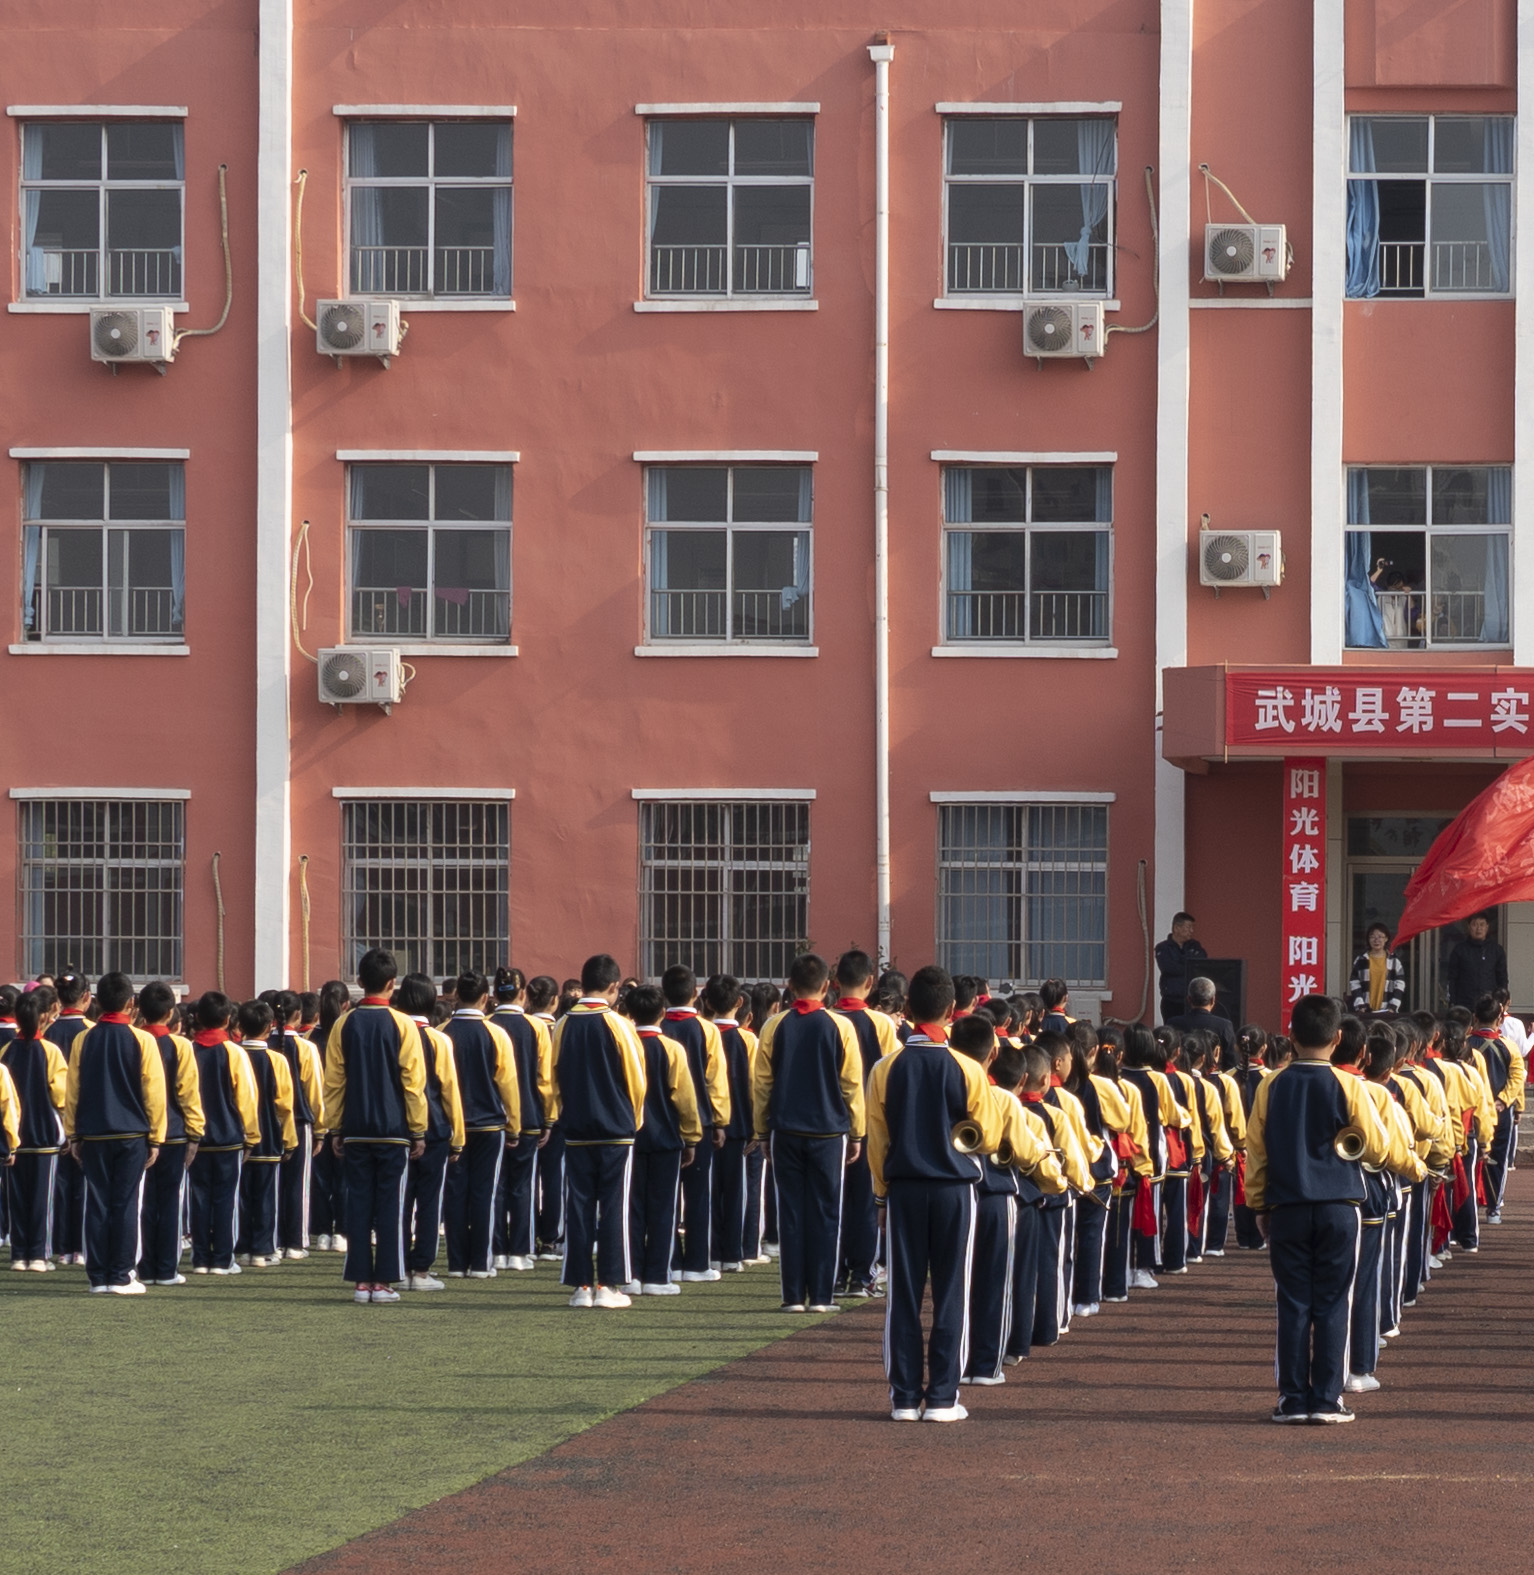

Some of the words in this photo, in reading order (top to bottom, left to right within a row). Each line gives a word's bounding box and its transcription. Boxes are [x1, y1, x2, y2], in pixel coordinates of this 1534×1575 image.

[1288, 768, 1320, 913] 阳光体育
[1287, 935, 1319, 1031] 阳光
